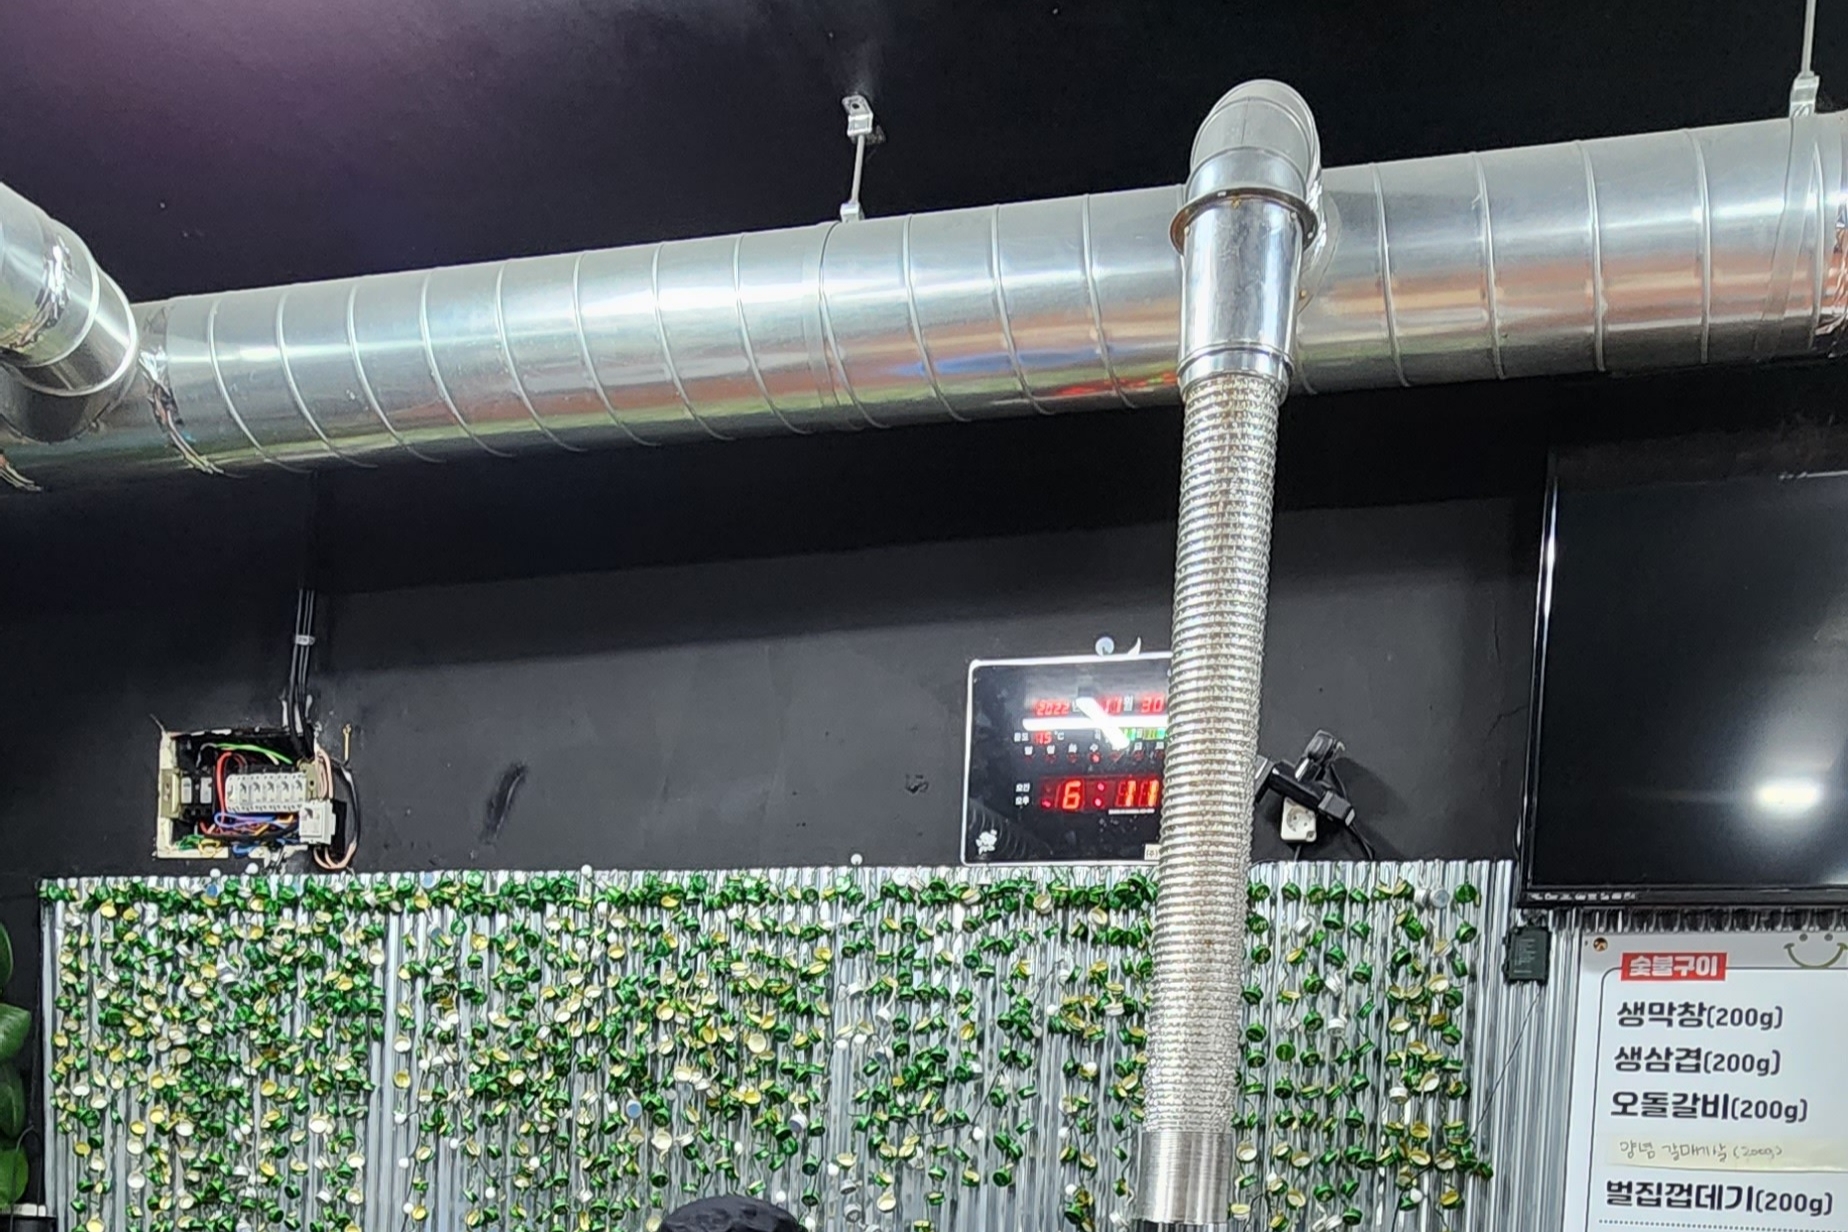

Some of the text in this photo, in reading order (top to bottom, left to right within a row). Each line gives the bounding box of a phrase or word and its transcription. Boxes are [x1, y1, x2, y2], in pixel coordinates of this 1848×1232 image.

[1629, 955, 1718, 977] 숯불구이
[1617, 1001, 1783, 1031] 생막창(200g)
[1614, 1046, 1781, 1077] 생삼겹(200g)
[1610, 1091, 1808, 1123] 오돌갈비(200g)
[1606, 1180, 1833, 1217] 벌집껍데기(200g)
